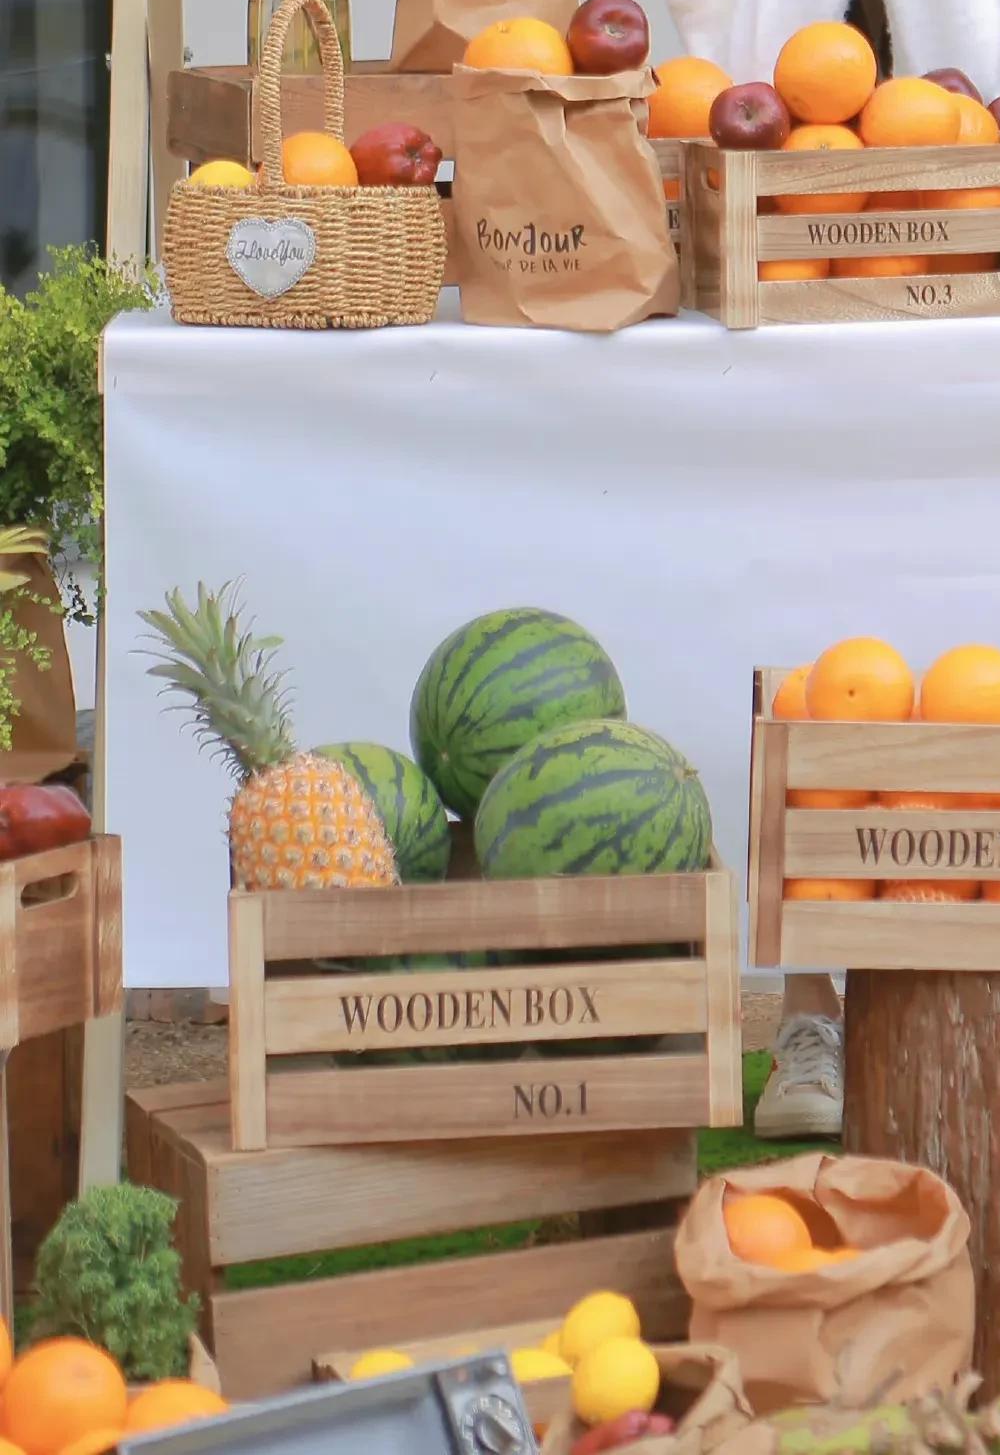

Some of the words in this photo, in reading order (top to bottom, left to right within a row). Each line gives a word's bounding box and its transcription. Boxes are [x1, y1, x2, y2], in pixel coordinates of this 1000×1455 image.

[807, 221, 902, 245] WOODEN
[907, 220, 951, 242] BOX
[520, 259, 537, 273] DE
[905, 284, 953, 306] NO.3
[339, 988, 513, 1035] WOODEN
[523, 985, 602, 1026] BOX
[512, 1081, 589, 1120] NO.1
